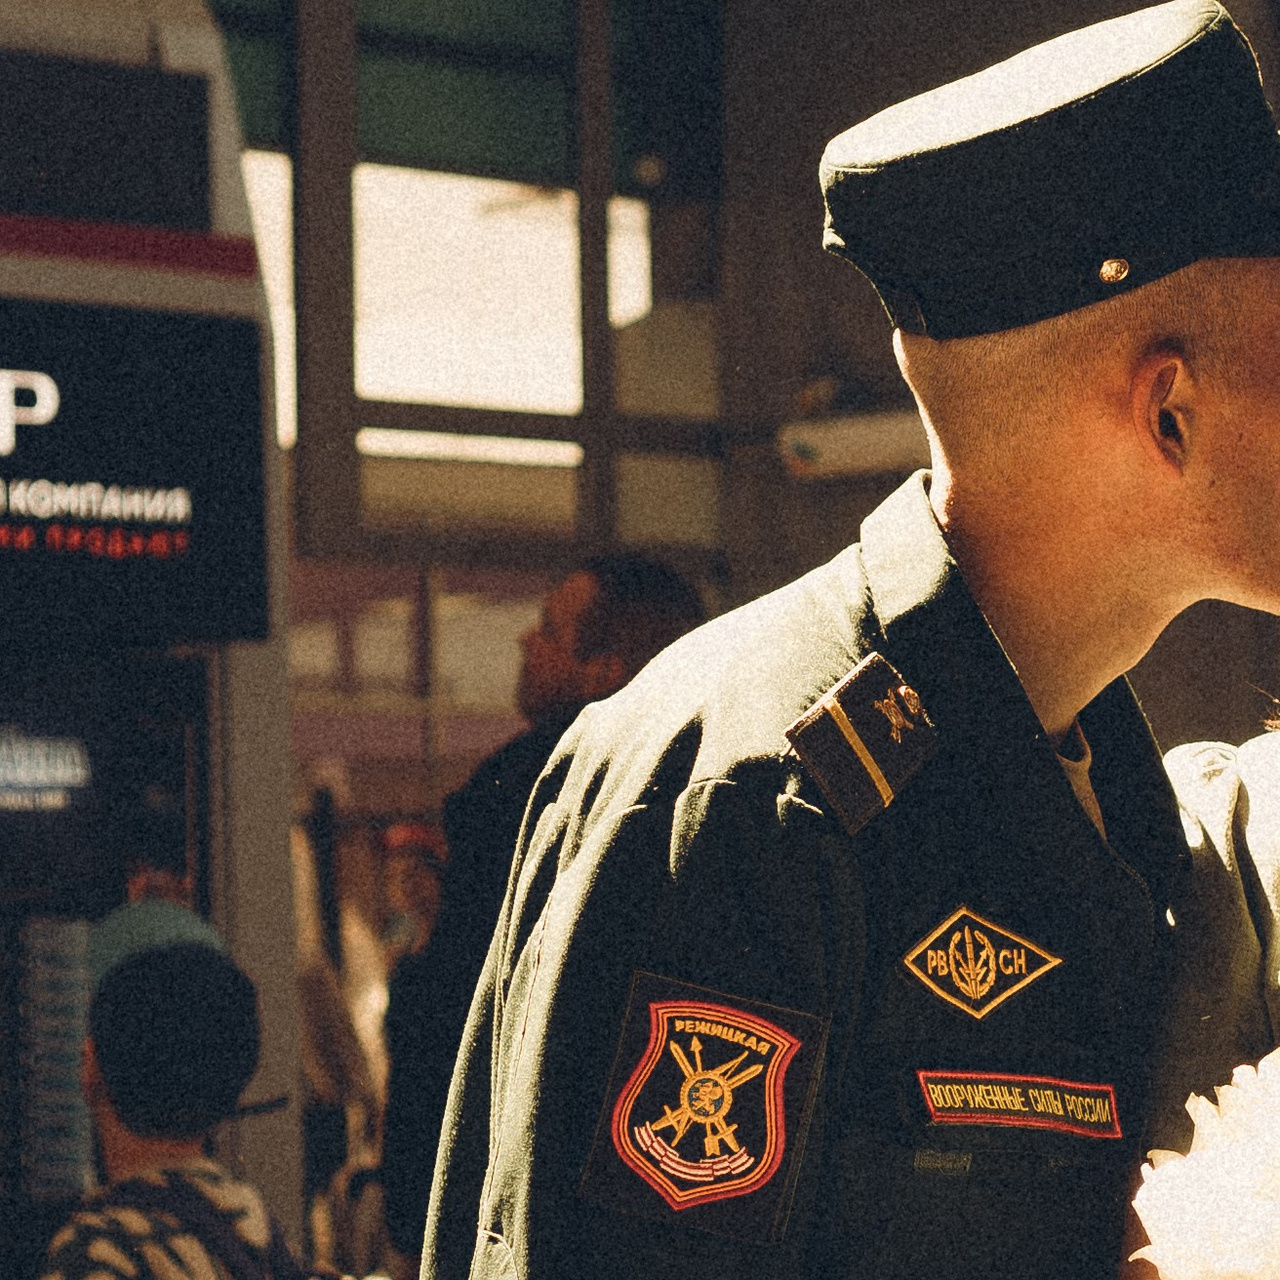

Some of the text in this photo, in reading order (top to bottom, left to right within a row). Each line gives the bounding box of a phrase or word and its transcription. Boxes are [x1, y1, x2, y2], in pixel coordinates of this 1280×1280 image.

[9, 478, 192, 522] КОМПАНИЯ
[927, 948, 1028, 976] РВ СН
[674, 1019, 770, 1056] РЕЖИЦКАЯ
[928, 1083, 1112, 1123] ВООРУЖЕННЫЕ СИЛЫ РОССИИ
